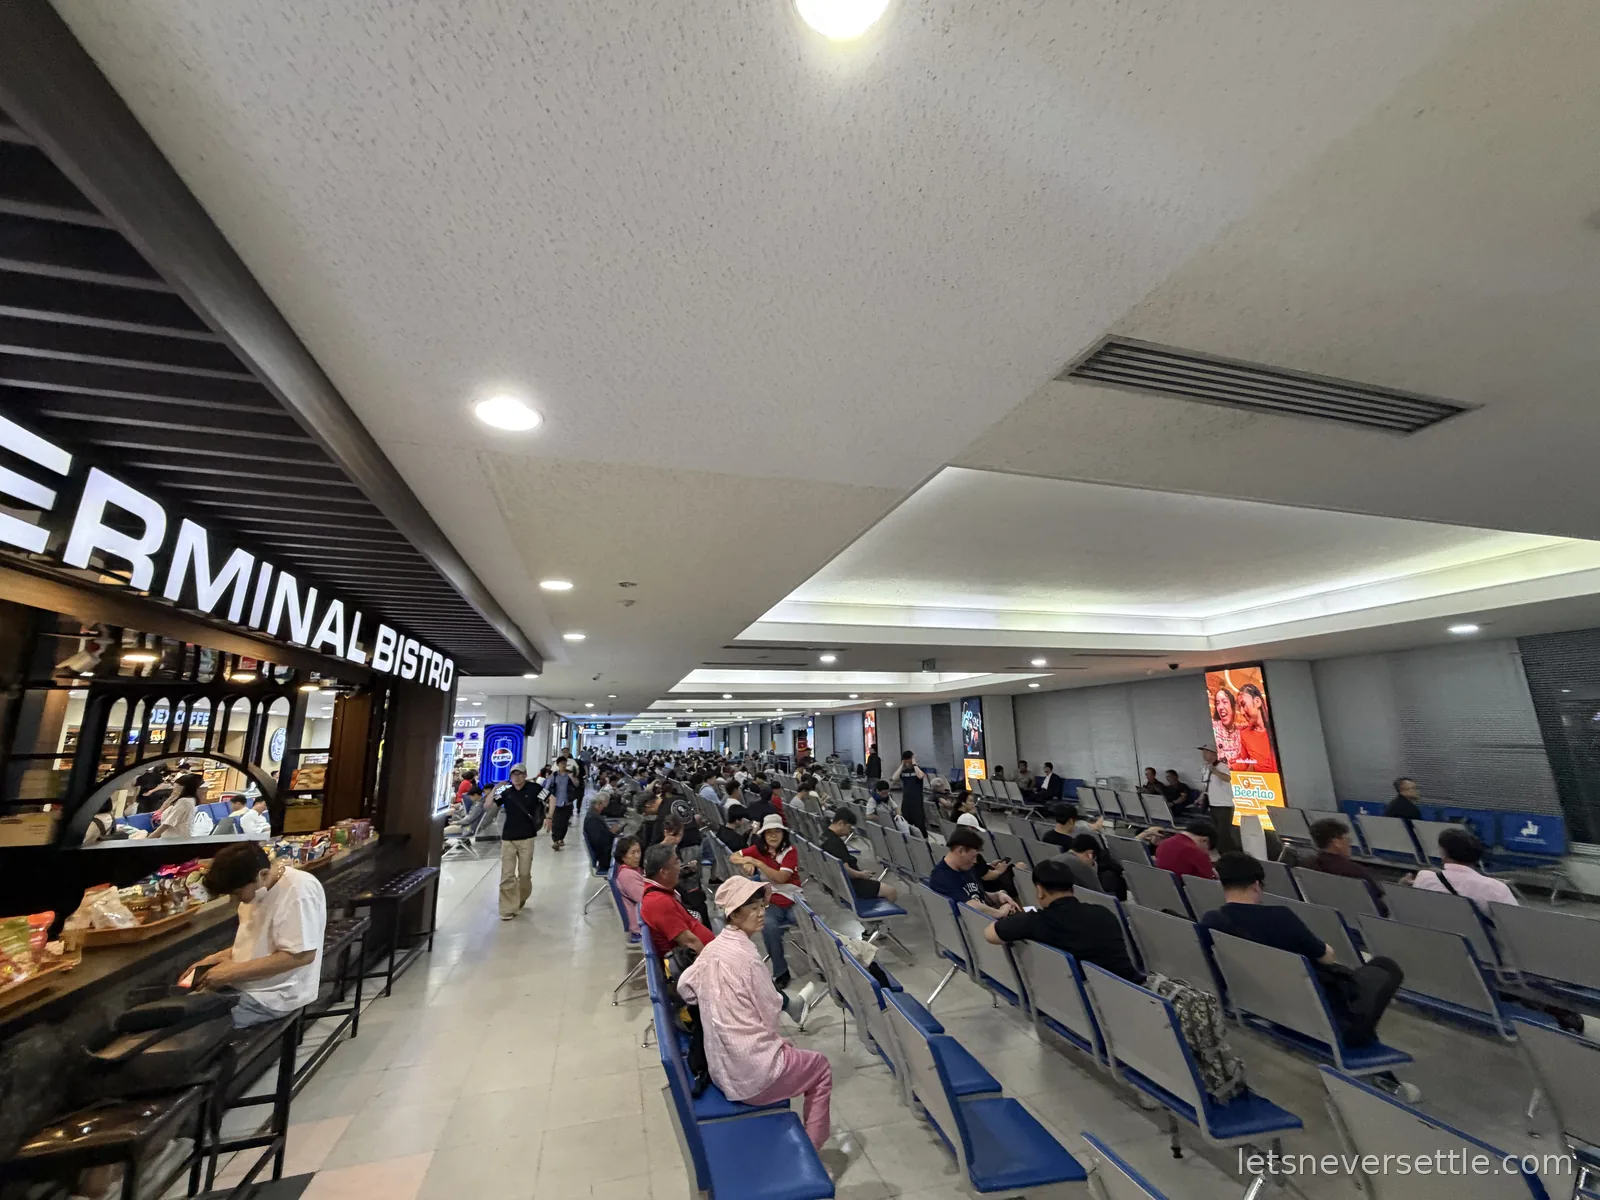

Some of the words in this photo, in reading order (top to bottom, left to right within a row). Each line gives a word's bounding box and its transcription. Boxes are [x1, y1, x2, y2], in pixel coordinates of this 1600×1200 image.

[0, 415, 367, 665] ERMINAL
[372, 623, 454, 692] BISTRO
[1233, 785, 1275, 799] Beerlao
